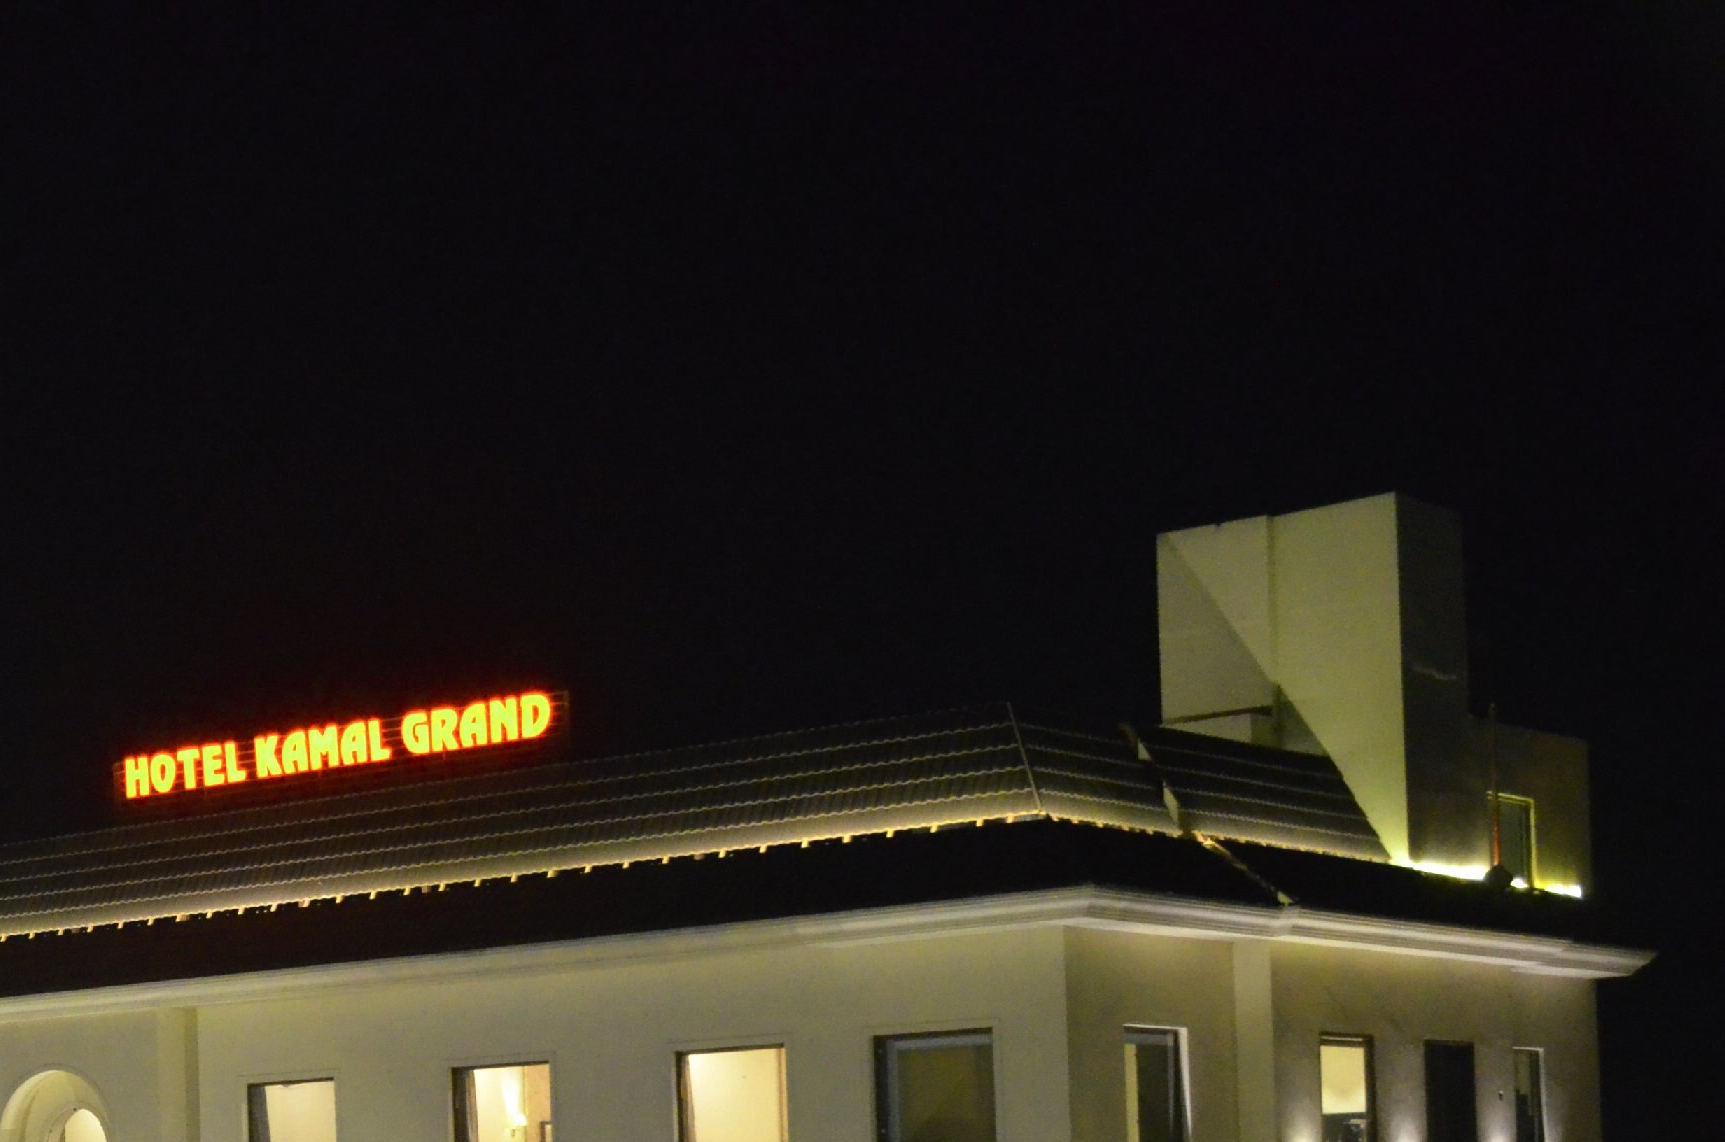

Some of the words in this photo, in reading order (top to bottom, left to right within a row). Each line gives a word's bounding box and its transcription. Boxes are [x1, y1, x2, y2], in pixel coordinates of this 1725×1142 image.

[124, 740, 247, 800] HOTEL
[253, 719, 391, 778] KAMAL
[400, 691, 552, 755] GRAND
